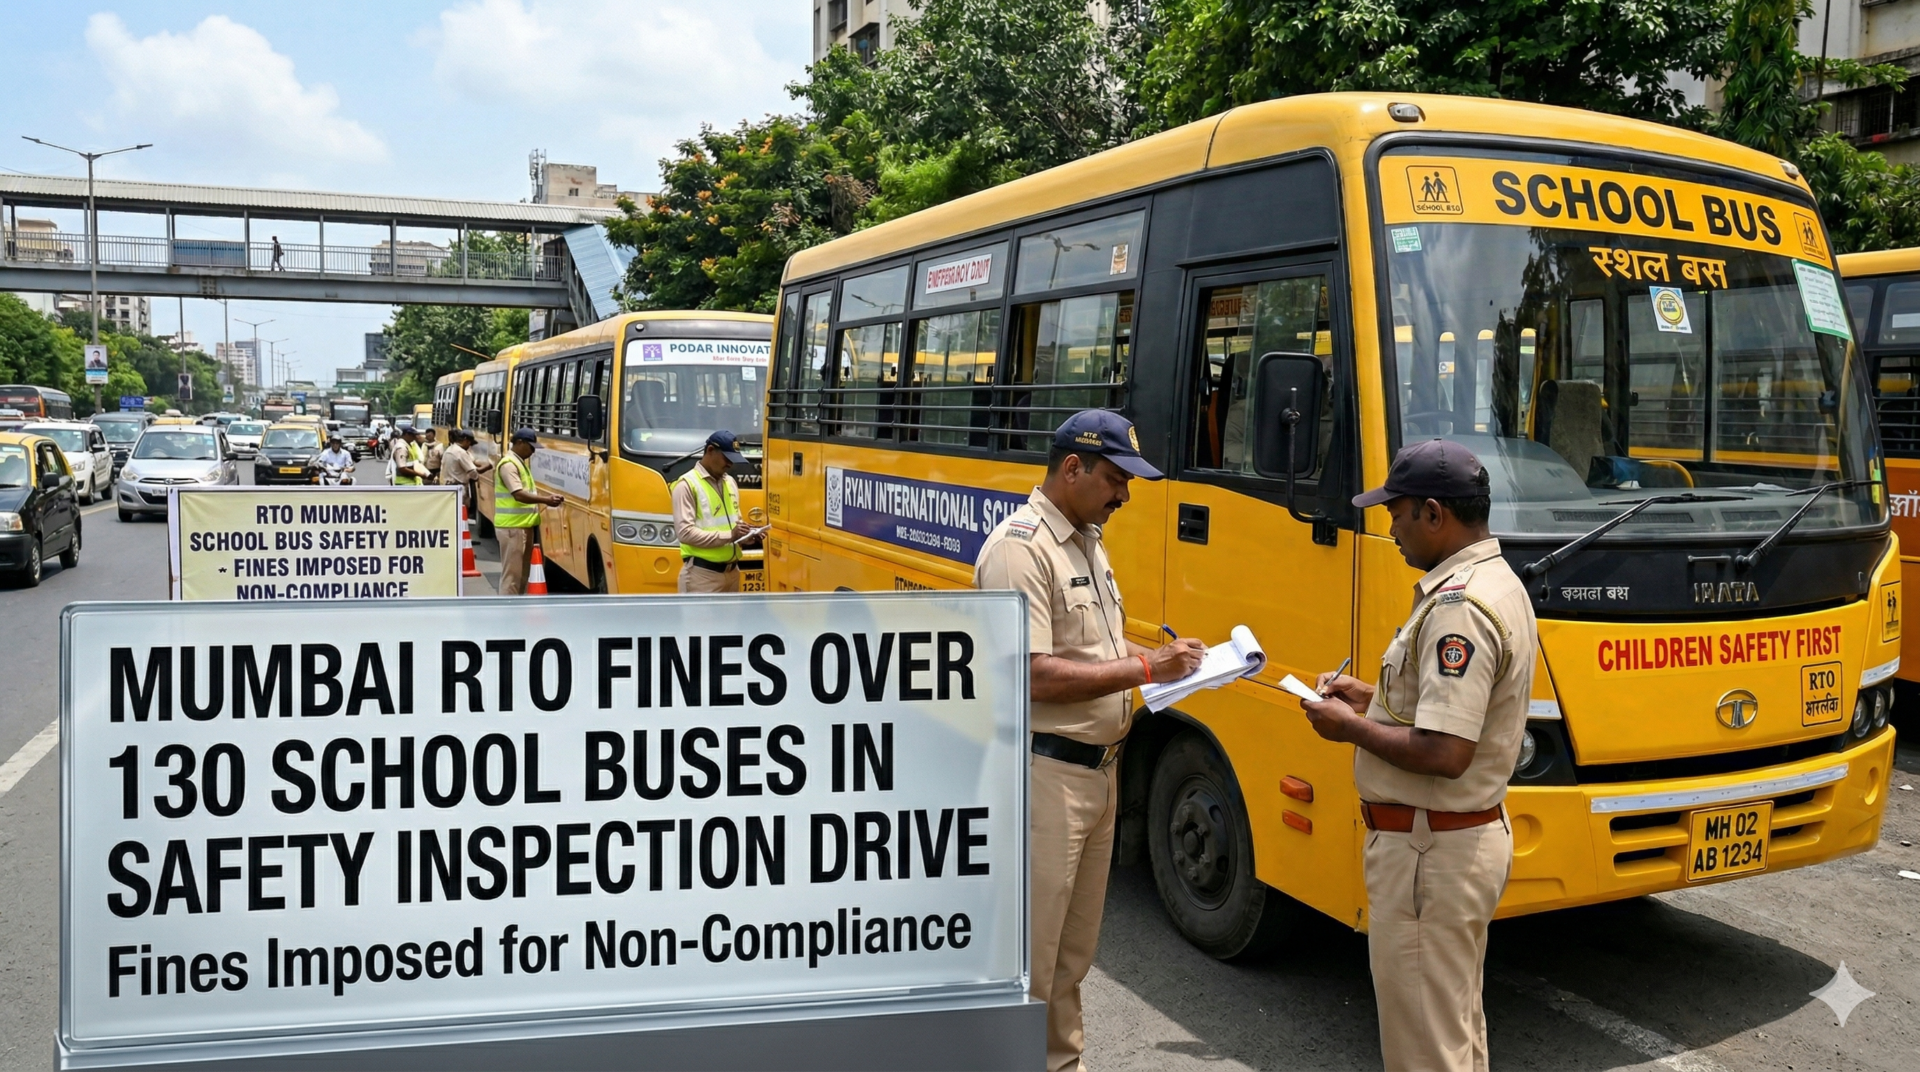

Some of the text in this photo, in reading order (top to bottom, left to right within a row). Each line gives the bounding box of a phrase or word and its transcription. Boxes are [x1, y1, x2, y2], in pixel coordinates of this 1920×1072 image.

[1492, 170, 1781, 246] SCHOOL BUS
[1677, 254, 1728, 289] बस
[669, 343, 714, 354] PODAR
[256, 504, 388, 525] RTO MUMBAI:
[844, 476, 872, 511] RYAN
[875, 480, 979, 532] INTERNATIONAL
[189, 530, 449, 552] SCHOOL BUS SAFETY DRIVE
[234, 555, 424, 578] FINES IMPOSED FOR
[236, 581, 409, 600] NON-COMPLIANCE
[1598, 625, 1842, 672] CHILDREN SAFETY FIRST
[110, 630, 976, 723] MUMBAI RTO FINES OVER
[1809, 670, 1835, 690] RTO
[109, 722, 894, 820] 130 SCHOOL BUSES IN
[1705, 811, 1758, 841] MH 02
[107, 806, 990, 919] SAFETY INSPECTION DRIVE
[1693, 838, 1763, 874] AB 1234
[108, 905, 972, 998] Fines Imposed for Non-Compliance
